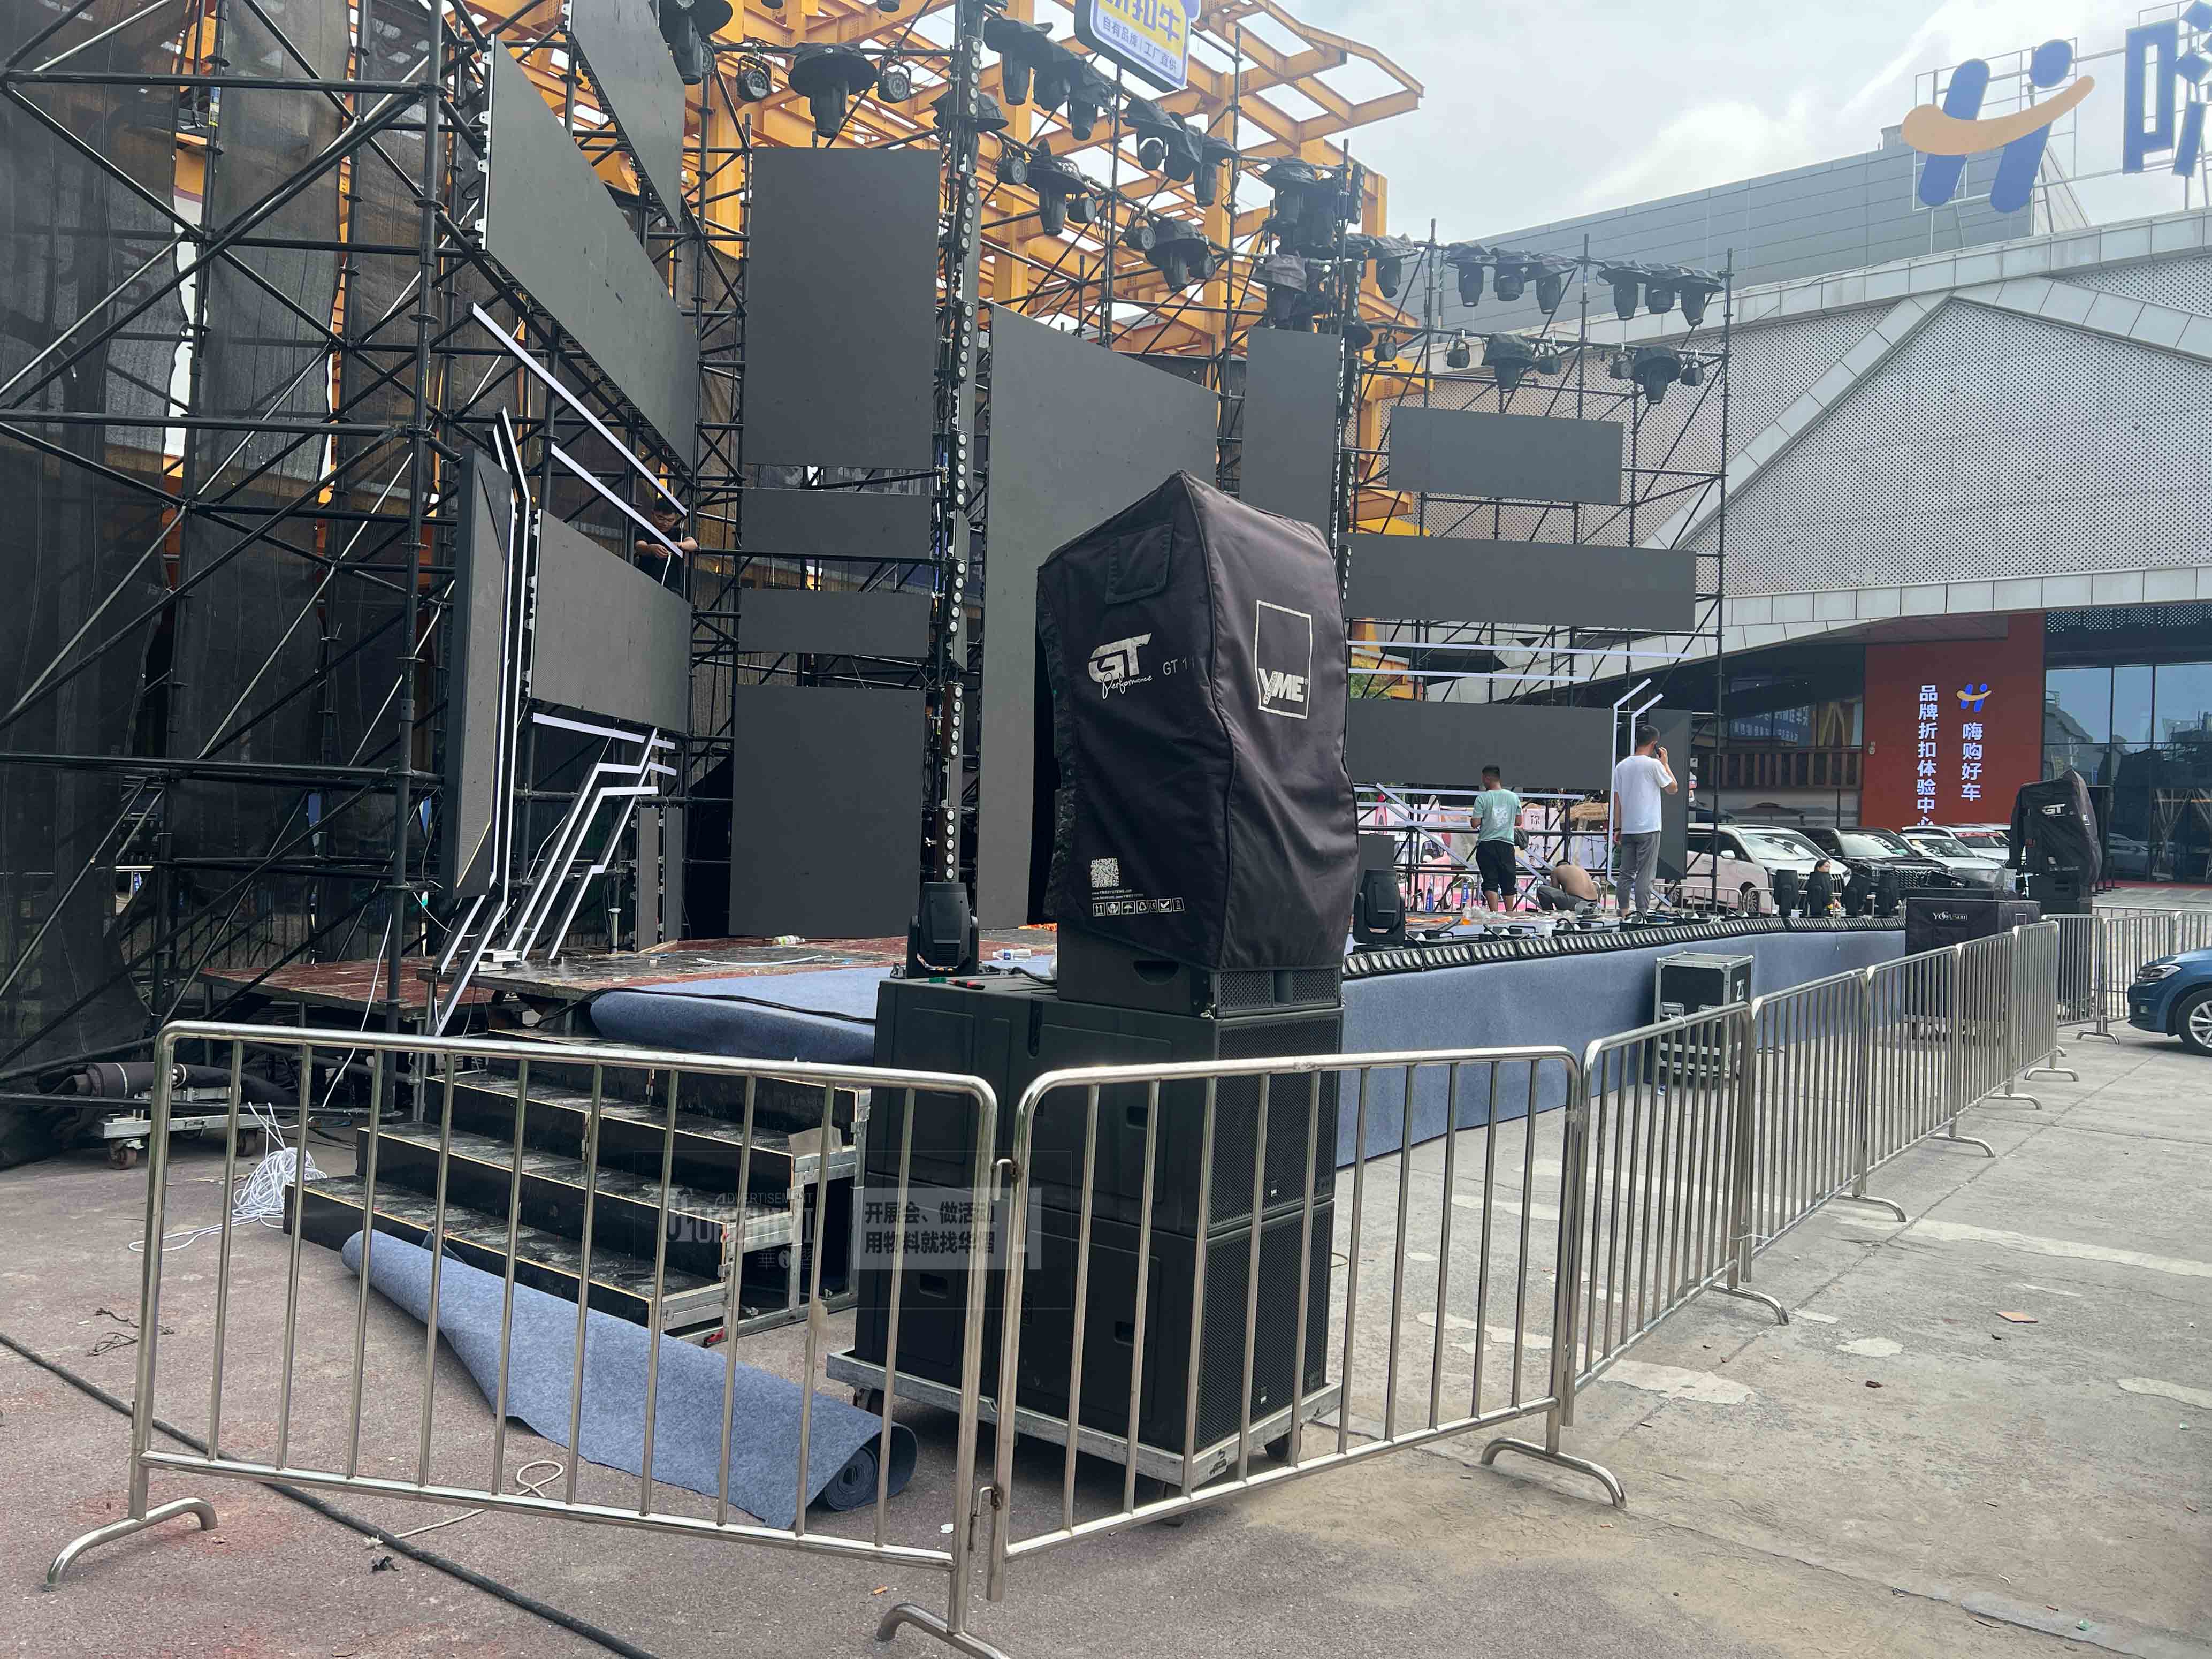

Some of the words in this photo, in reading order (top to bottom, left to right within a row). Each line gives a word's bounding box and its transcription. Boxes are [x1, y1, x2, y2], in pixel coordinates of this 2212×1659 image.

[1087, 633, 1152, 683] GT
[1163, 659, 1178, 676] GT
[1961, 722, 1983, 801] 嗨购好车
